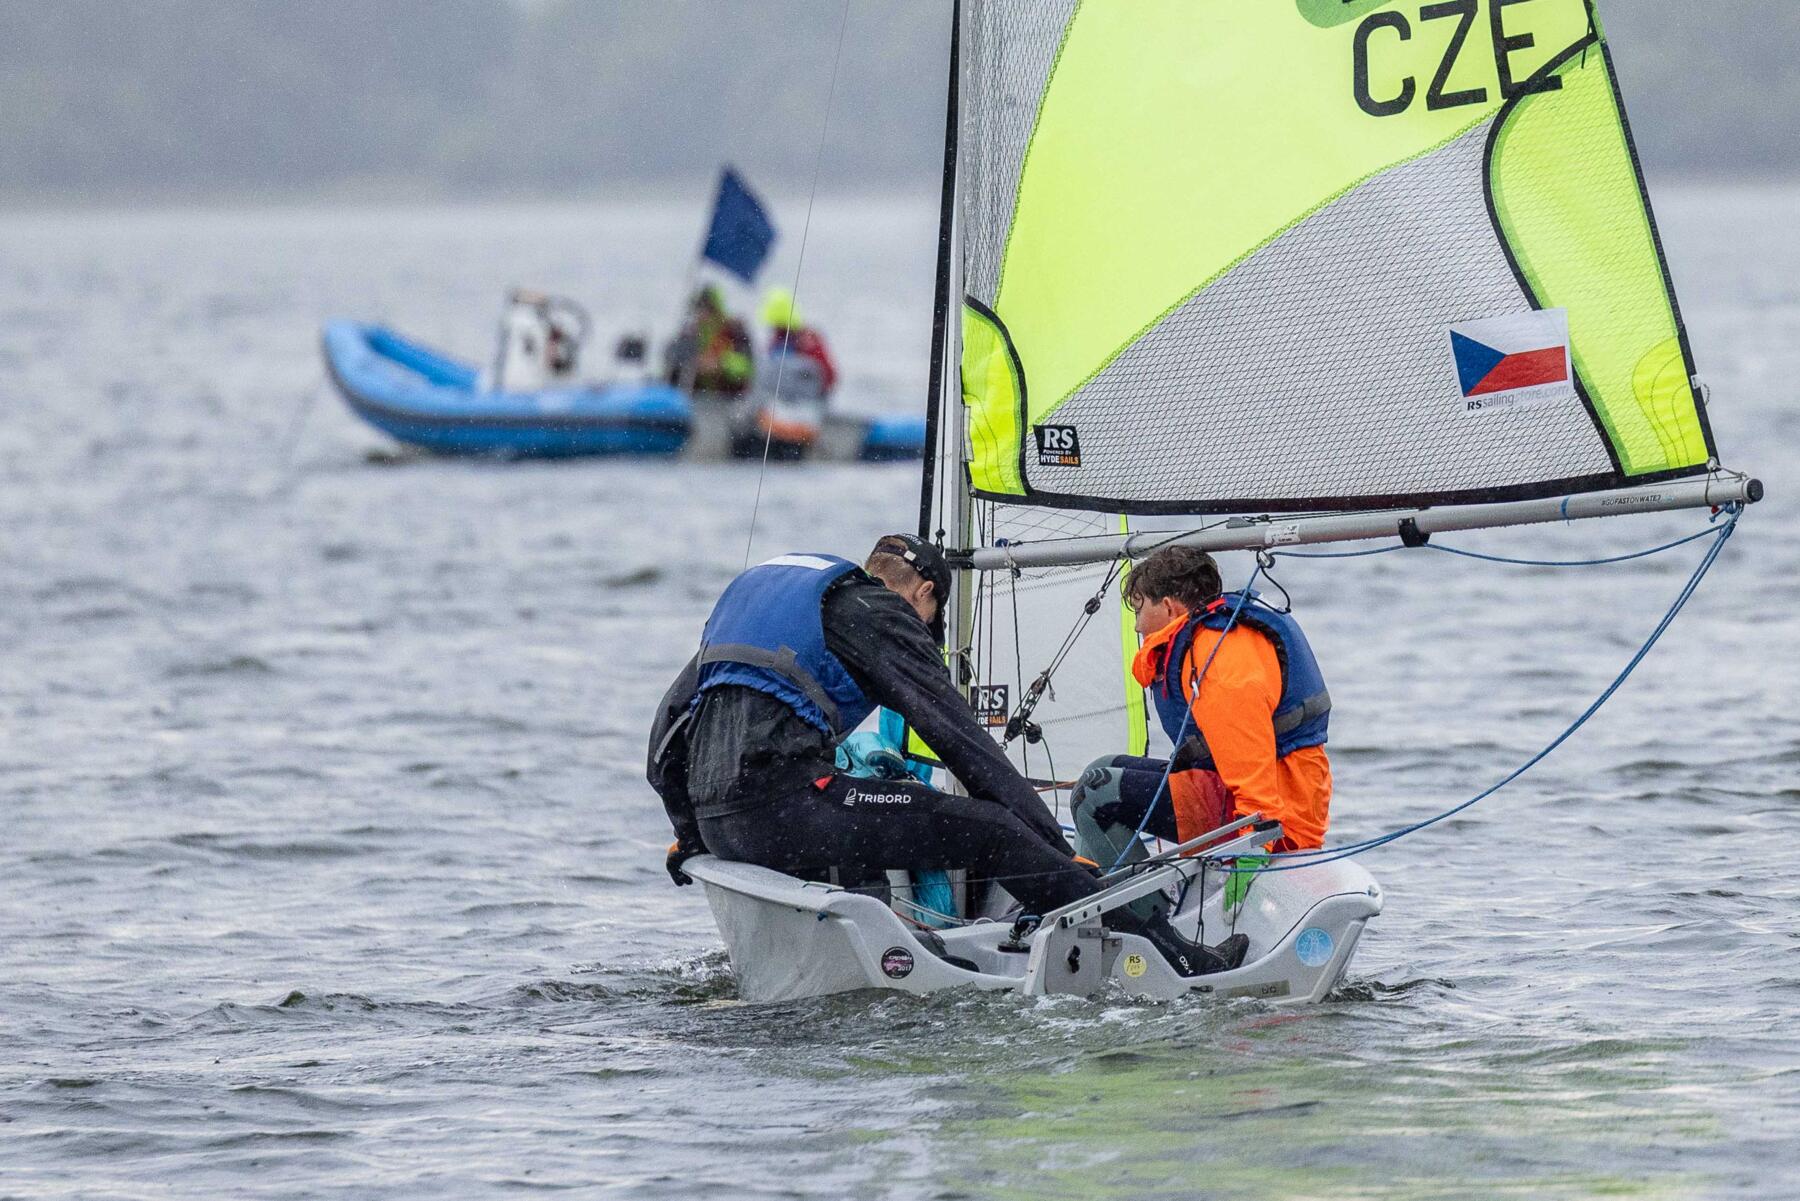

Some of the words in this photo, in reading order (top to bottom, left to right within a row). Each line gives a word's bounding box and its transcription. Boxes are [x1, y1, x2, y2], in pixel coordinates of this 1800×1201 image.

[1353, 0, 1563, 117] CZE
[1044, 428, 1074, 449] RS
[1040, 454, 1079, 465] HYDESAILS
[978, 688, 1005, 710] RS
[858, 793, 912, 804] TRIBORD
[1129, 955, 1141, 964] RS
